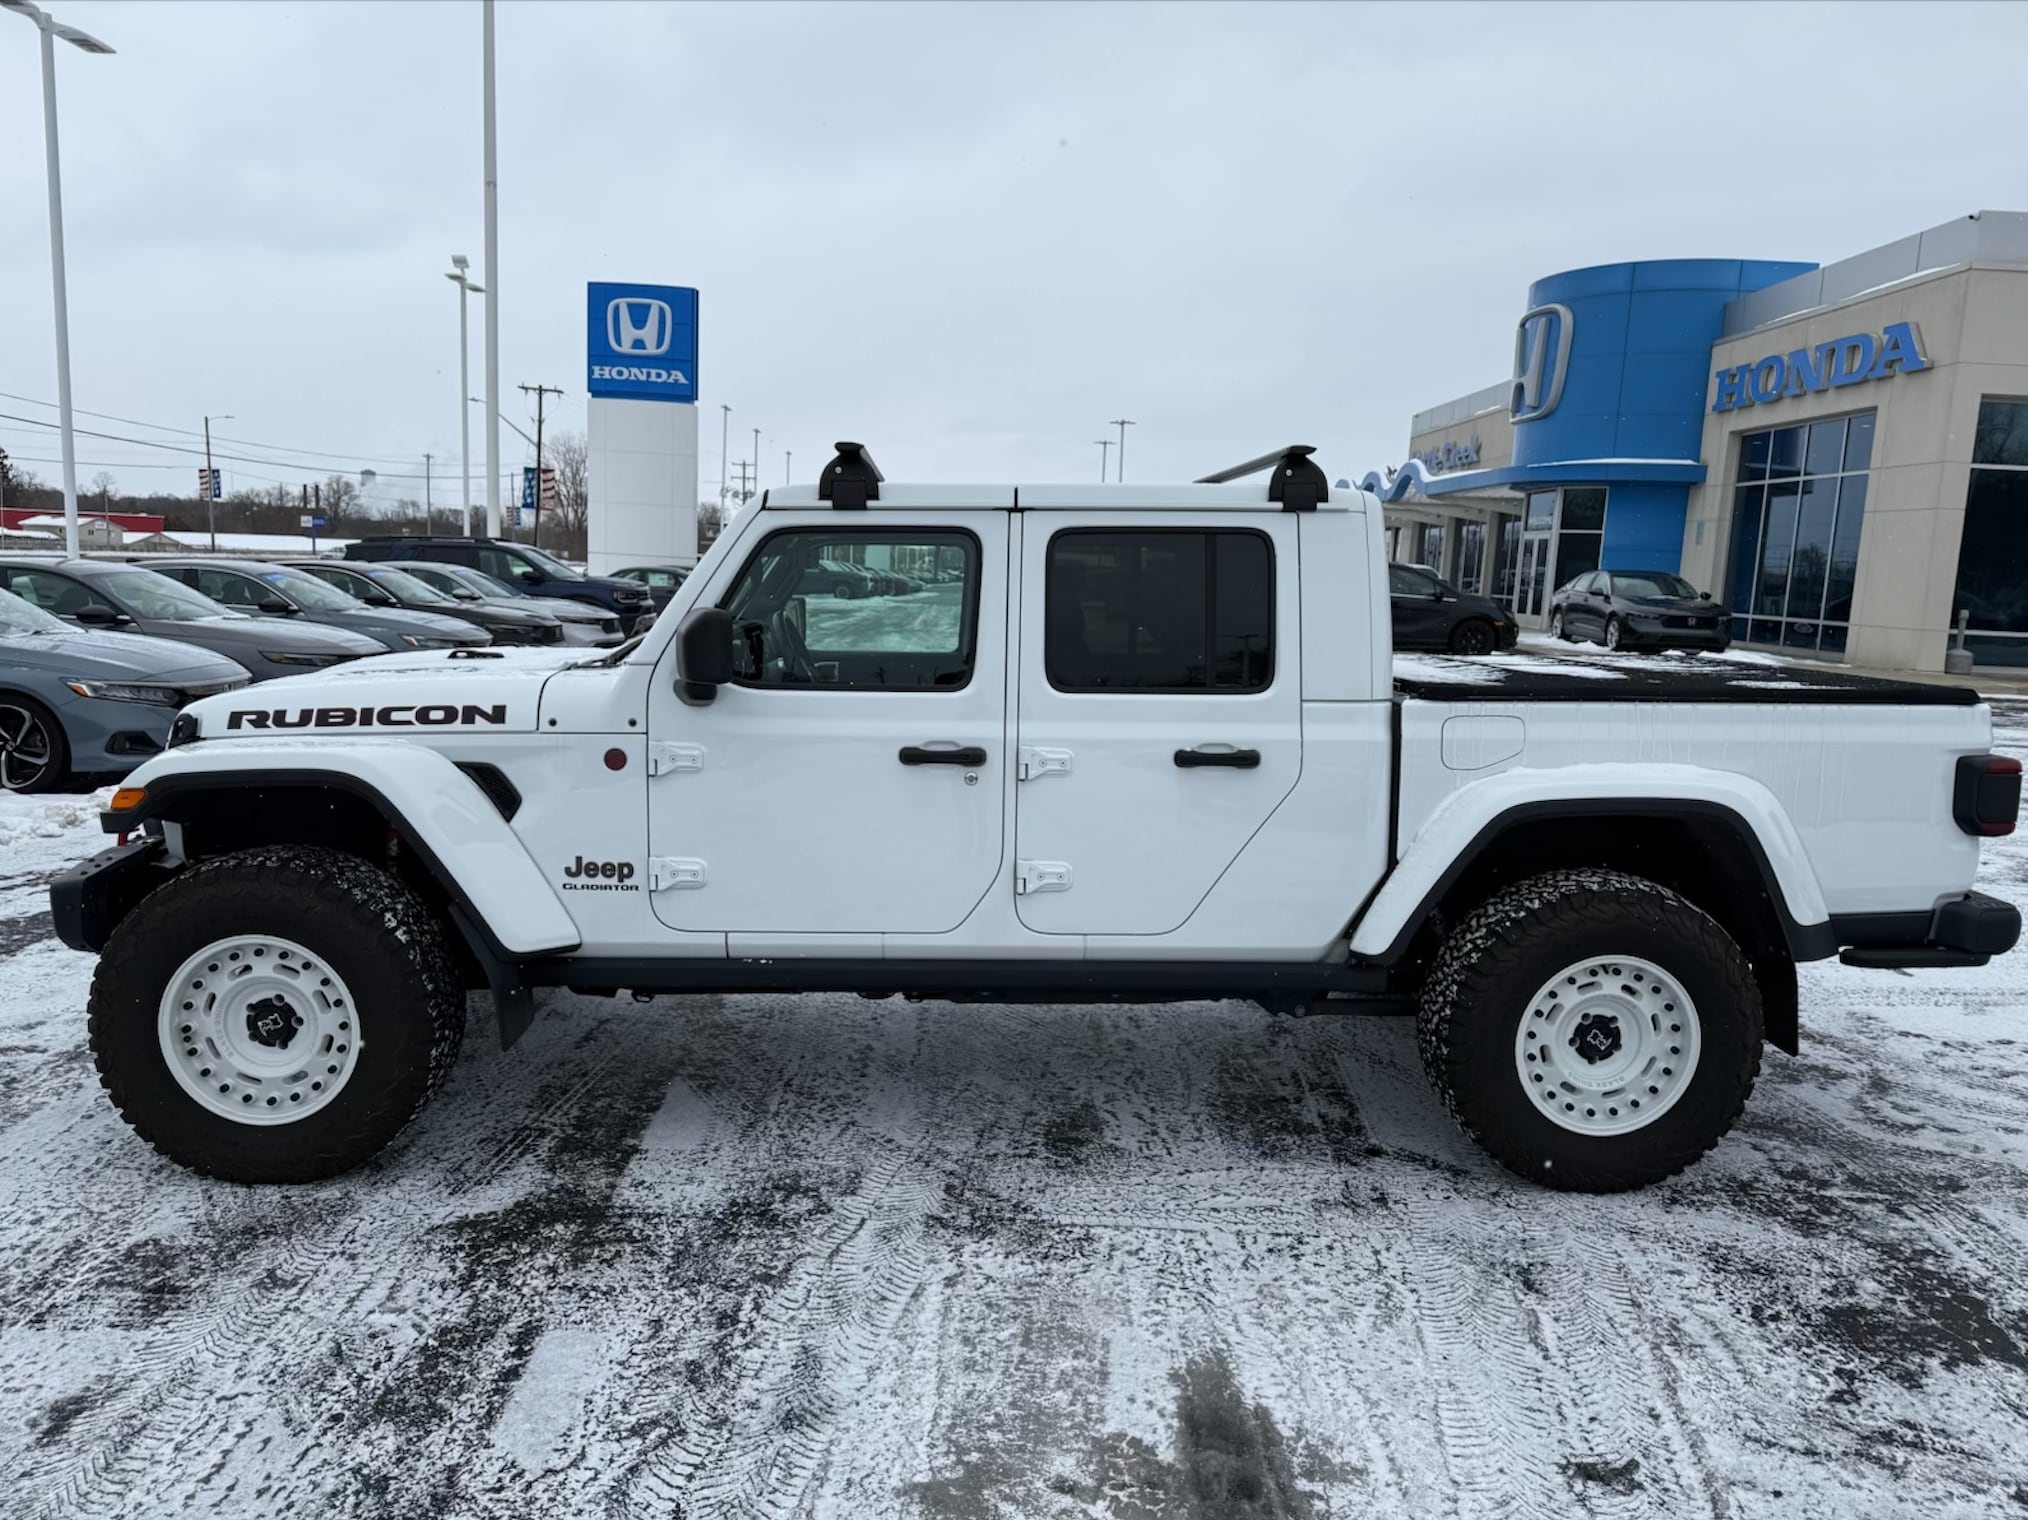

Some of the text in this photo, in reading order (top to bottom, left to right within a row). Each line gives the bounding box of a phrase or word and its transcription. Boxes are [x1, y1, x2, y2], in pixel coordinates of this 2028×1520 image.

[592, 365, 688, 384] HONDA
[1711, 321, 1929, 412] HONDA
[226, 704, 507, 730] RUBICON
[564, 856, 634, 882] Jeep
[562, 883, 639, 891] GLADIATOR
